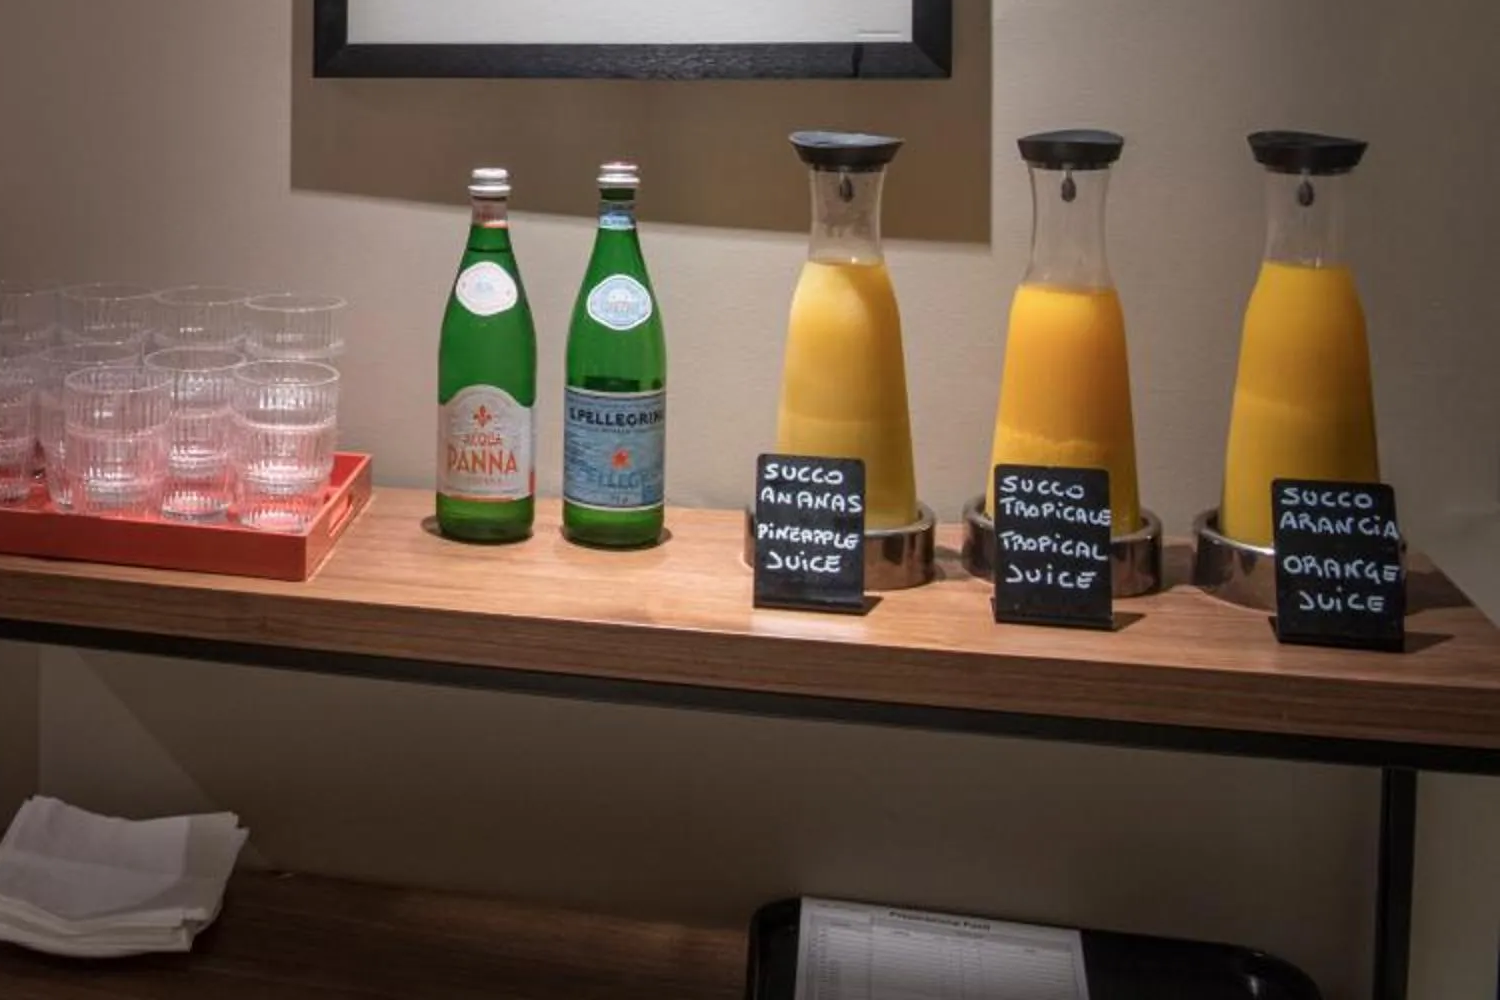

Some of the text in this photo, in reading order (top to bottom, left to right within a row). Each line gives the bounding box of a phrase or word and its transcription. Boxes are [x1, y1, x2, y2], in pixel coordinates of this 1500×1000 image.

[446, 443, 518, 475] PANNA
[764, 462, 843, 485] SUCCO
[760, 486, 863, 514] ANANAS
[1000, 475, 1085, 499] SUCCO
[1280, 487, 1374, 509] SUCCO
[1283, 555, 1400, 583] ORANGE
